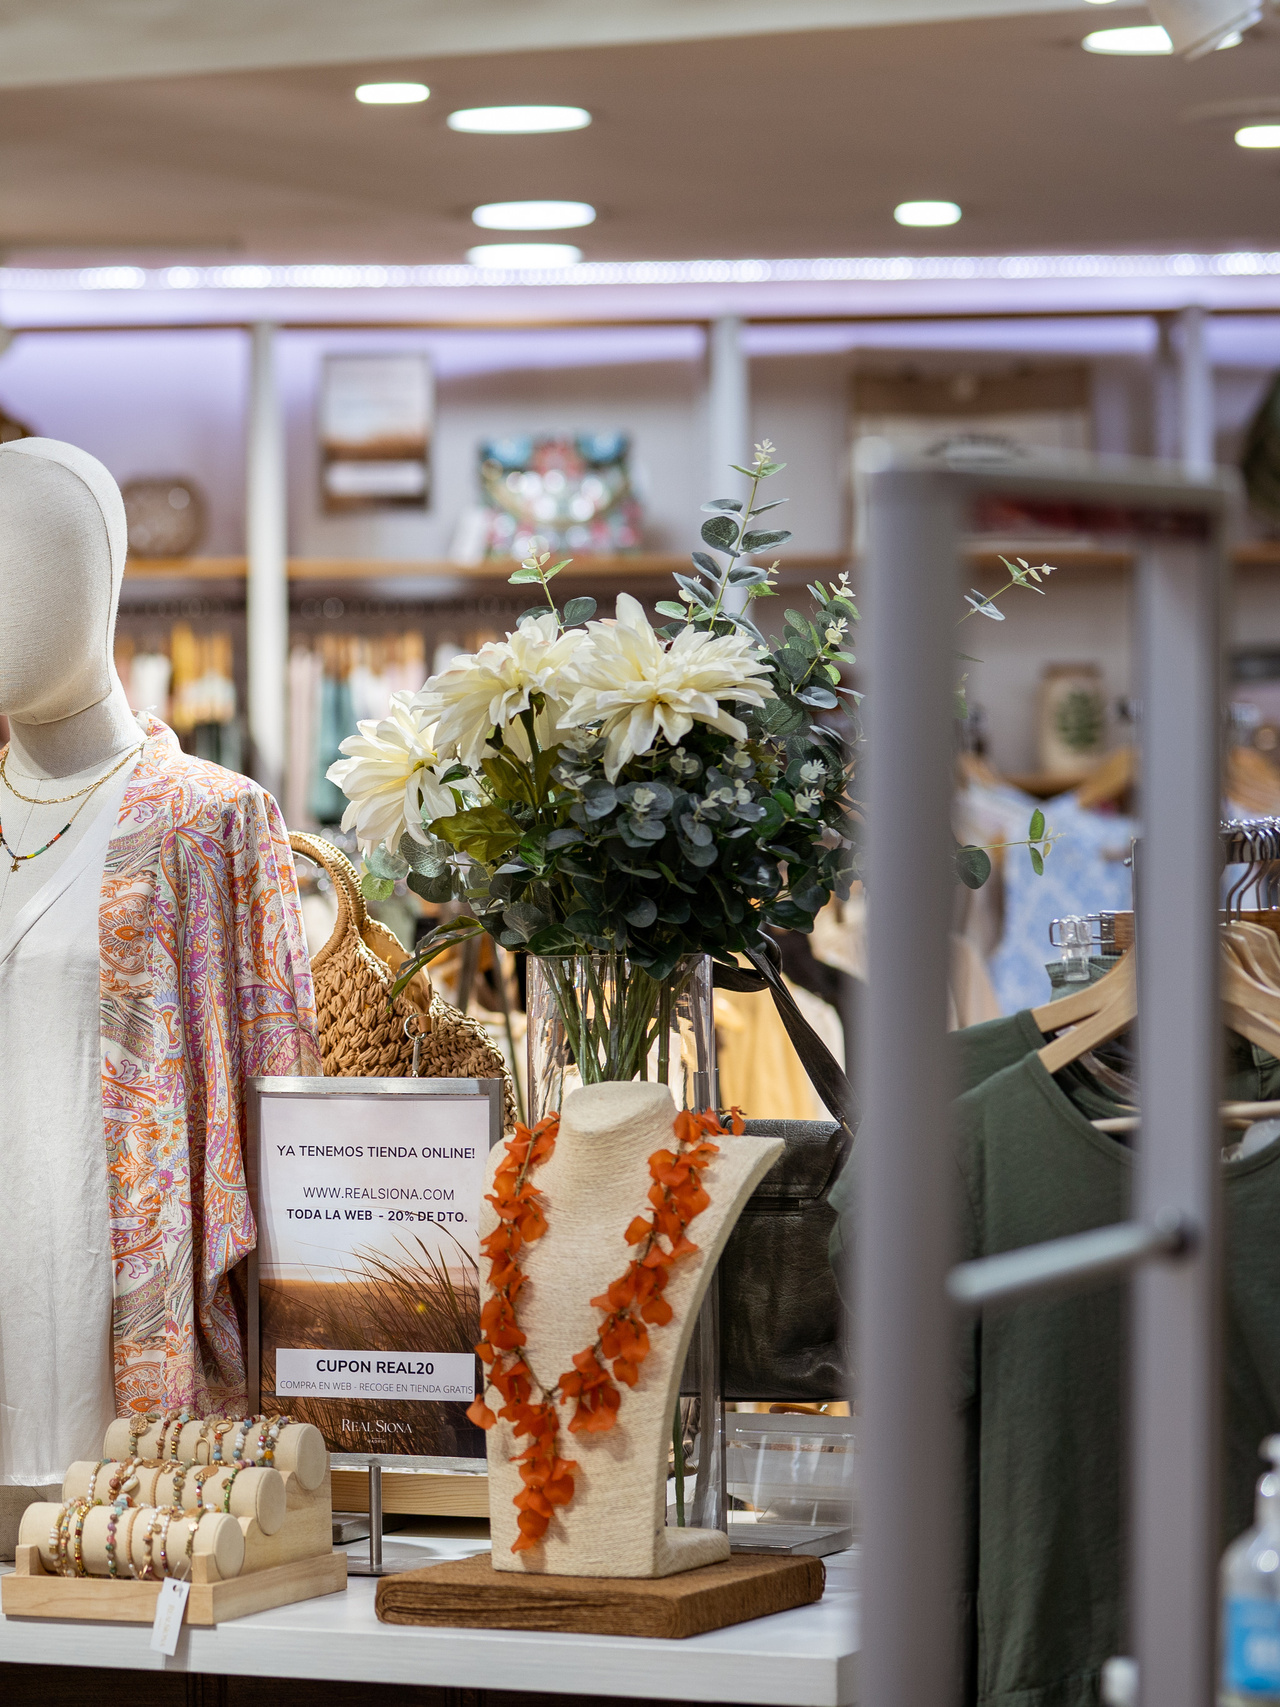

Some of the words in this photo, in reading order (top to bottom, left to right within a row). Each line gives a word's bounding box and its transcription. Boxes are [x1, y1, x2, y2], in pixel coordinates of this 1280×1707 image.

[277, 1145, 296, 1157] YA
[299, 1145, 364, 1158] TENEMOS
[367, 1146, 418, 1158] TIENDA
[422, 1147, 476, 1159] ONLINE!
[303, 1187, 455, 1200] WWW.REALSIONA.COM
[287, 1209, 322, 1220] TODA
[325, 1209, 341, 1220] LA
[344, 1210, 373, 1220] WEB
[388, 1210, 414, 1222] 20%
[418, 1211, 434, 1222] DE
[437, 1211, 468, 1223] DTO.
[316, 1360, 371, 1373] CUPON
[376, 1361, 435, 1375] REAL20
[280, 1380, 317, 1389] COMPRA
[319, 1381, 331, 1390] EN
[333, 1382, 352, 1390] WEB
[359, 1382, 394, 1392] RECOGE
[396, 1384, 408, 1392] EN
[410, 1384, 441, 1393] TIENDA
[443, 1385, 473, 1394] GRATIS
